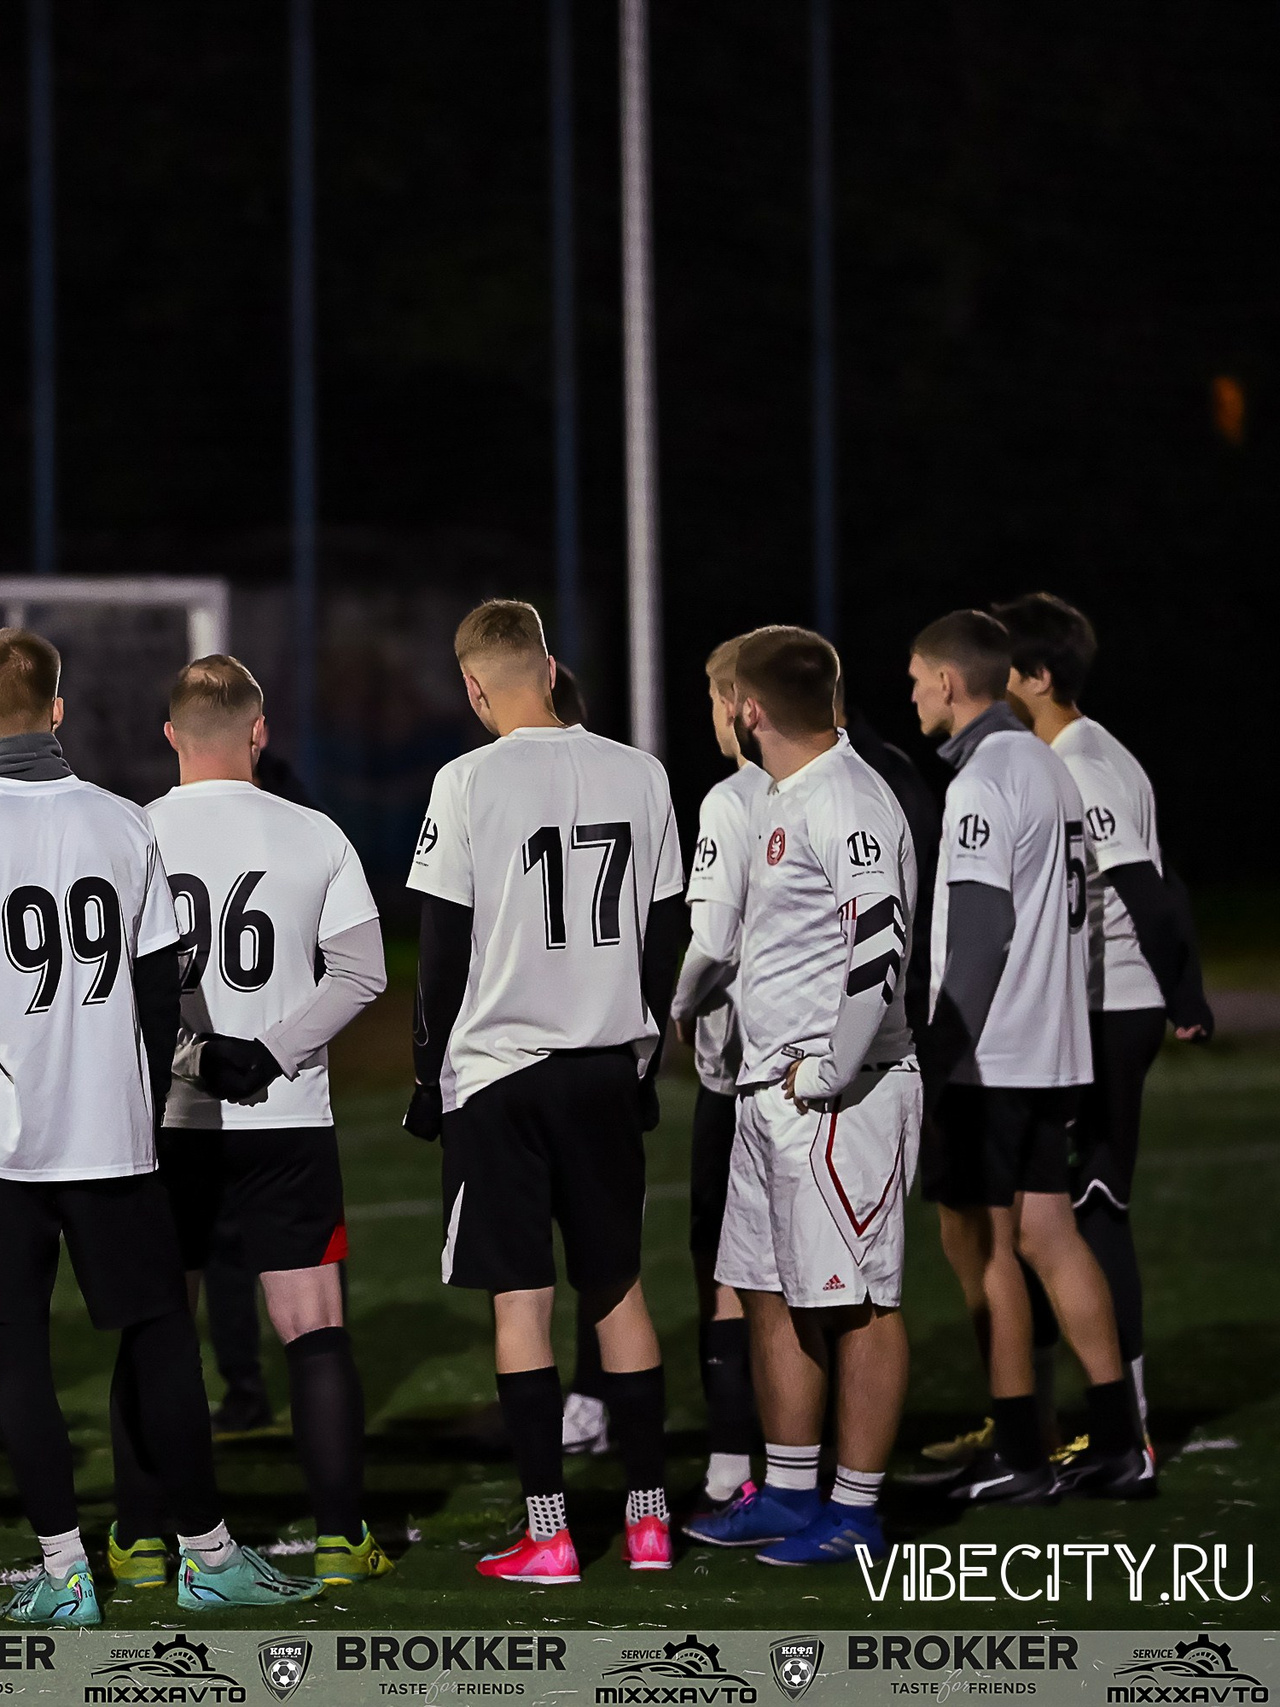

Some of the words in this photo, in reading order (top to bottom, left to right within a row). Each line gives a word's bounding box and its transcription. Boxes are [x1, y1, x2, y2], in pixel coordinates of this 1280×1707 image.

[2, 876, 122, 1015] 99
[174, 870, 275, 994] 96
[522, 821, 633, 951] 17
